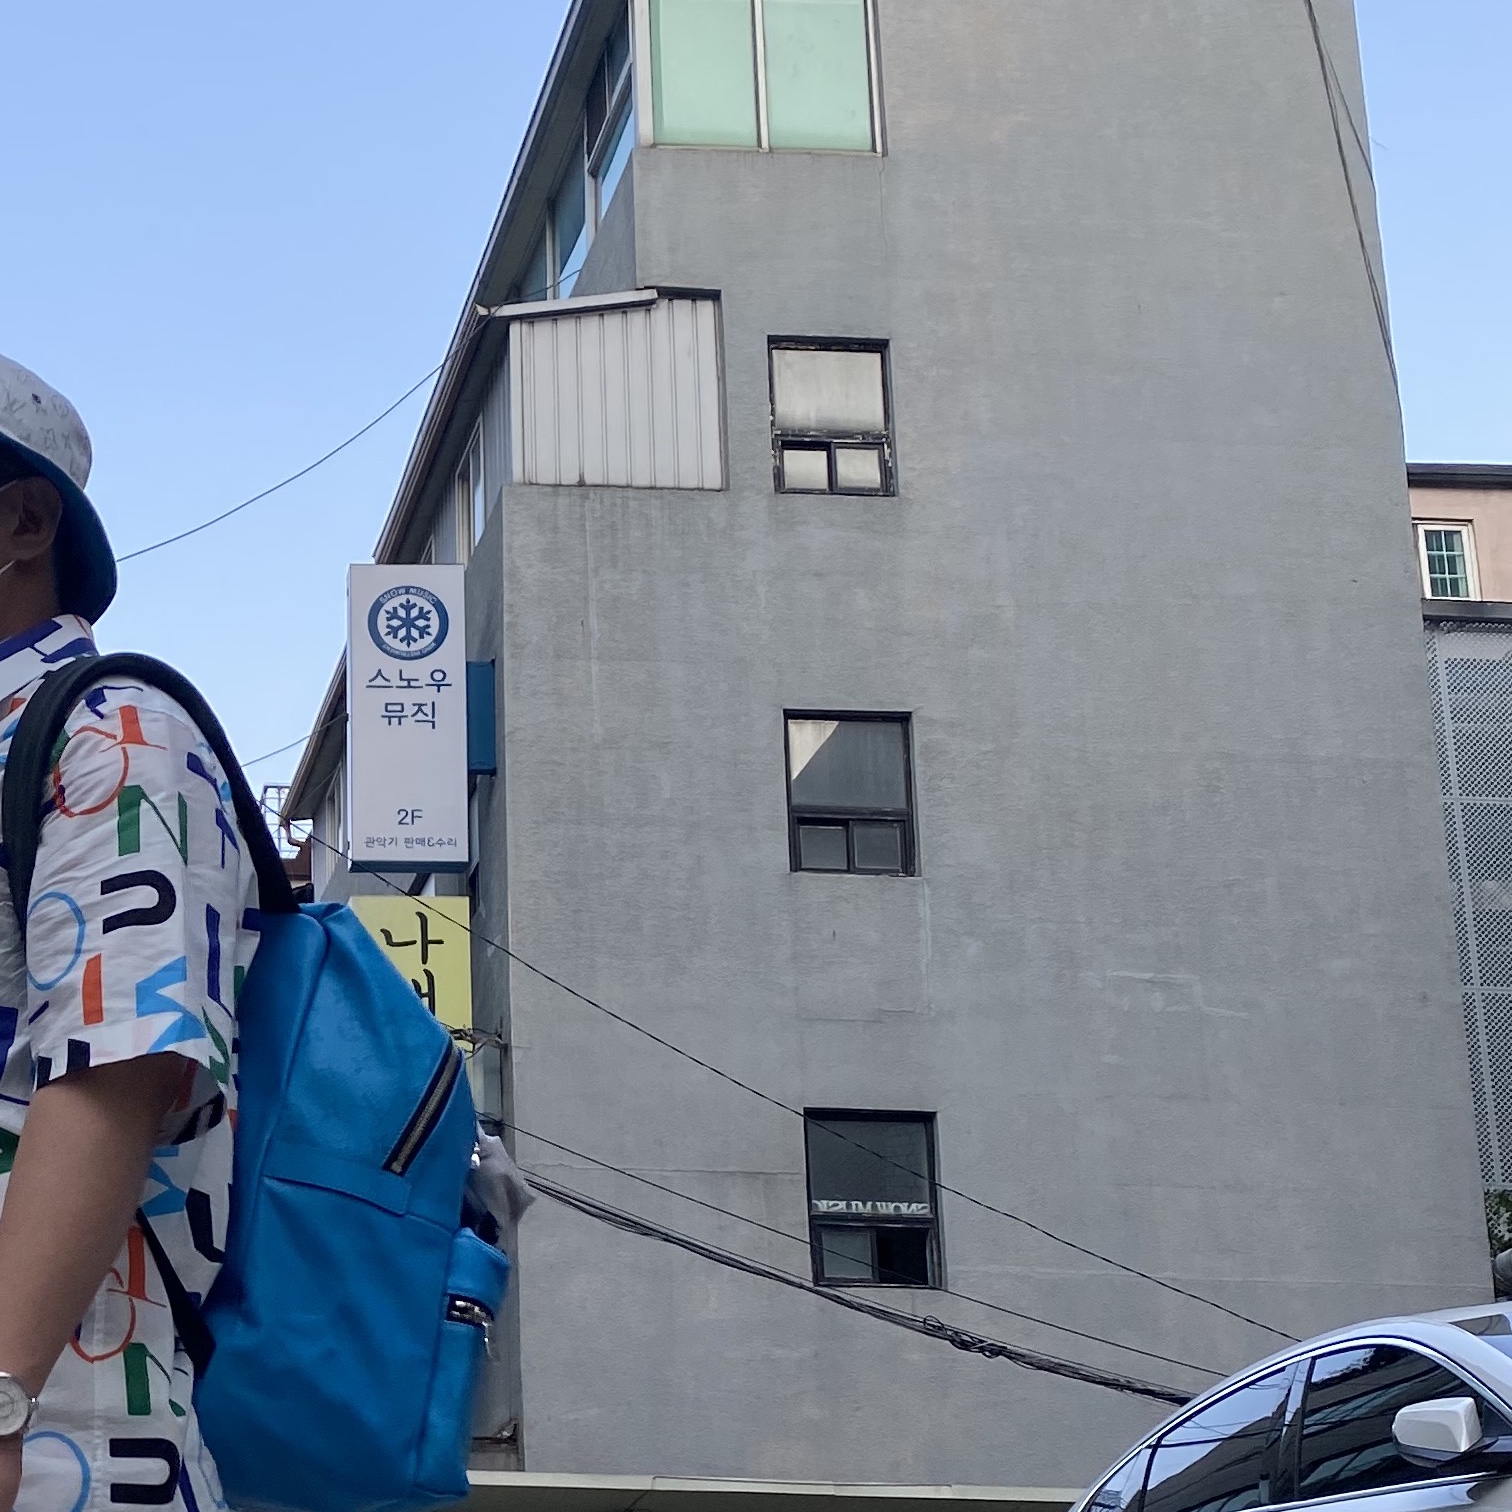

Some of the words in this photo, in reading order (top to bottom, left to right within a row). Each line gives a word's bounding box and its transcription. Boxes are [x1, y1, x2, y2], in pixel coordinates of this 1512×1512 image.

[379, 588, 405, 604] SNOW
[409, 588, 437, 604] MUSIC
[365, 668, 452, 692] 스노우
[381, 701, 436, 729] 뮤직
[397, 809, 423, 825] 2F
[364, 837, 398, 848] 관악기
